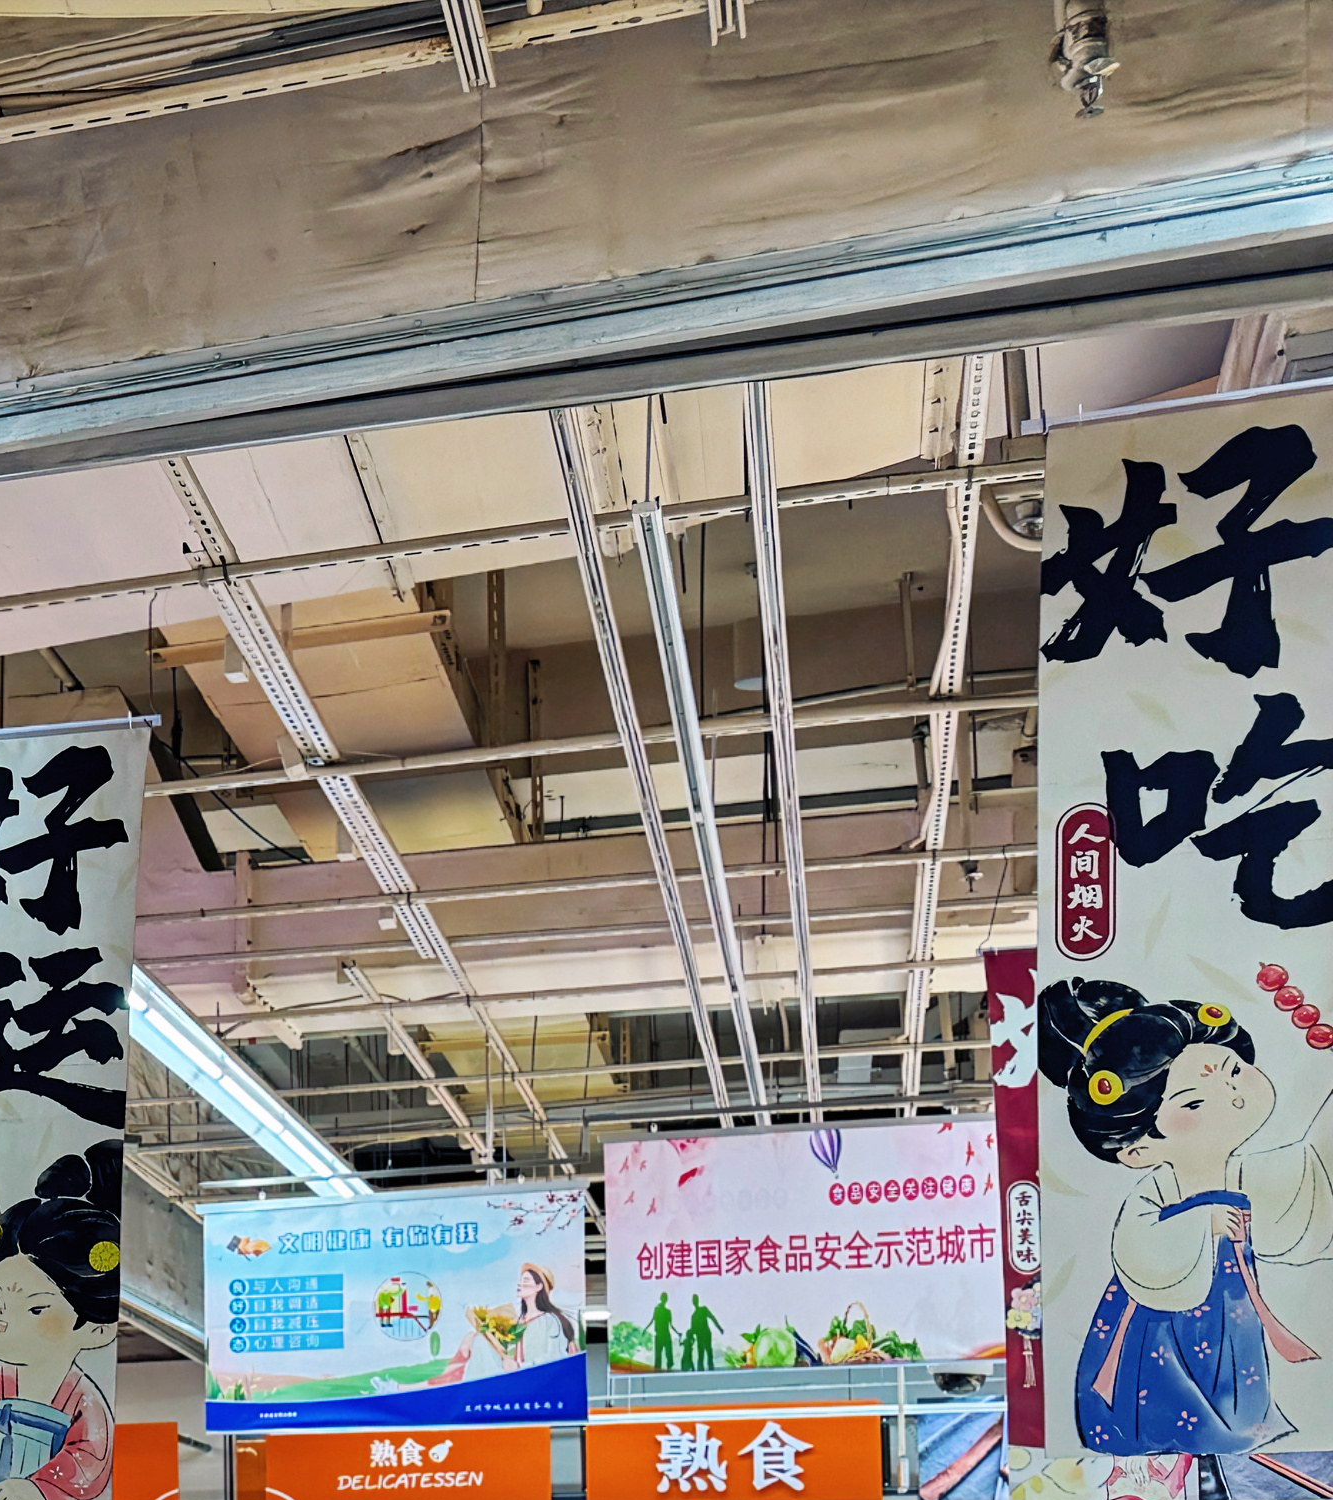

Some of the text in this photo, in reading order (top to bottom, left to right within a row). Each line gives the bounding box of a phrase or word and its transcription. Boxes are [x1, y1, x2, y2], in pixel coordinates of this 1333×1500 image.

[1040, 424, 1333, 930] 好吃
[1067, 822, 1107, 942] 人间烟火
[831, 1175, 974, 1203] 食品安全关注健康
[279, 1223, 479, 1255] 文明健康 有你有我
[1013, 1189, 1037, 1264] 舌尖美味
[636, 1223, 996, 1280] 创建国家食品安全示范城市
[253, 1278, 318, 1293] 与人沟通
[254, 1315, 319, 1331] 自我减压
[254, 1335, 319, 1350] 心理咨询
[369, 1438, 425, 1467] 熟食
[655, 1421, 813, 1493] 熟食
[337, 1471, 484, 1491] DELICATESSEN
